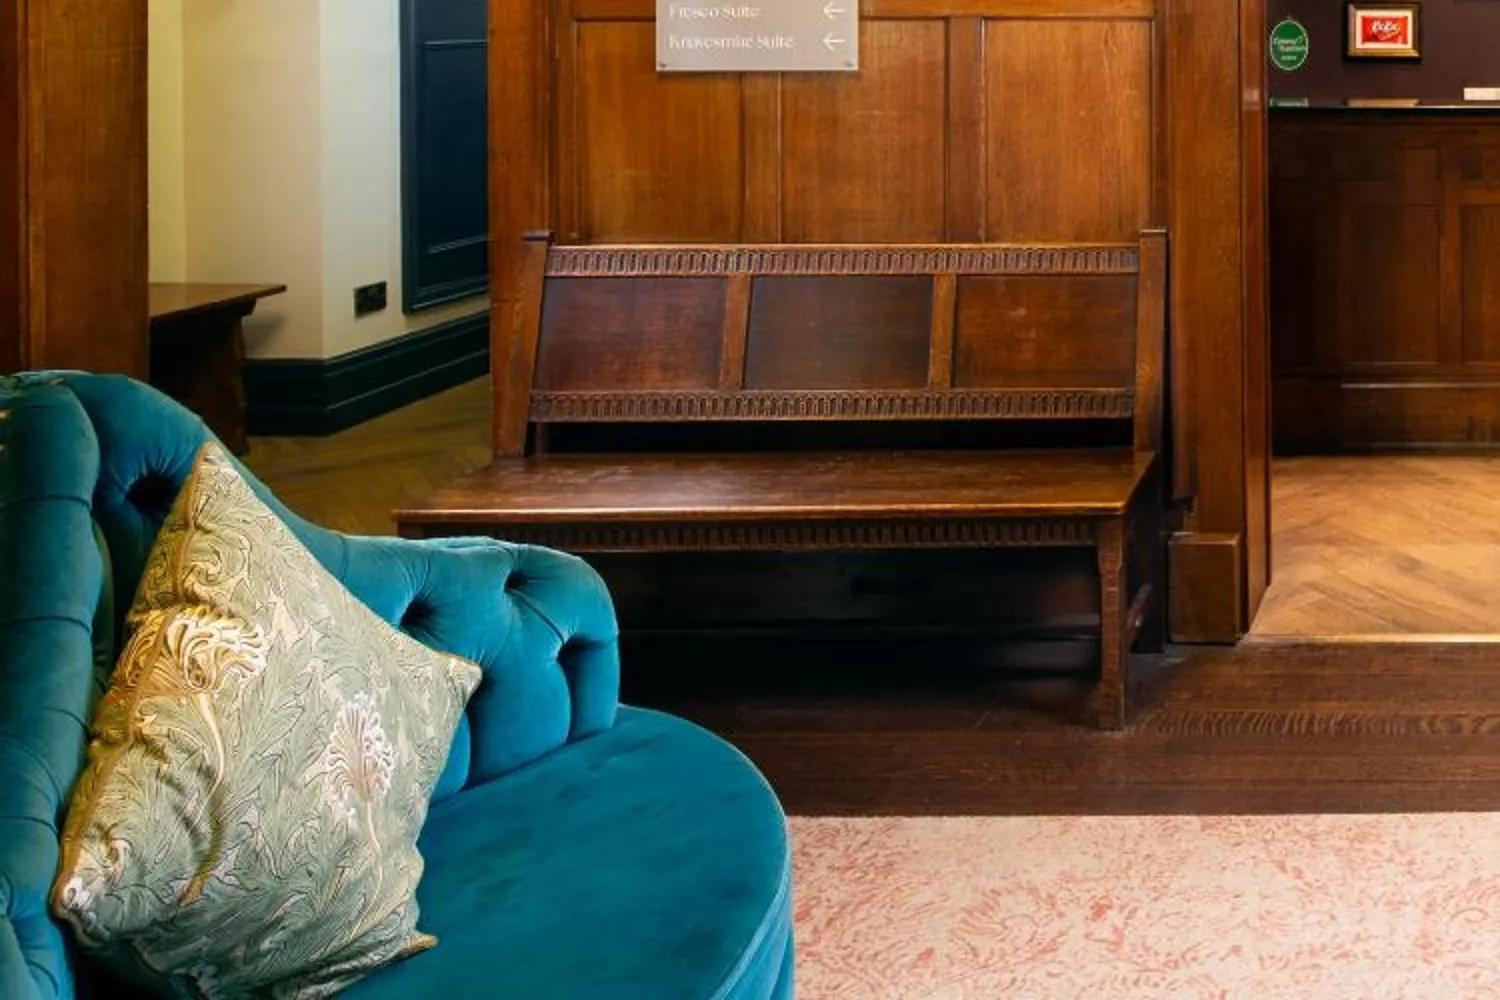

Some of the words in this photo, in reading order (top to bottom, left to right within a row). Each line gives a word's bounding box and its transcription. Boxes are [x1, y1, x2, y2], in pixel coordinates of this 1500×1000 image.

[668, 3, 719, 19] Fresco
[722, 4, 762, 19] Suite
[756, 34, 795, 49] Suite
